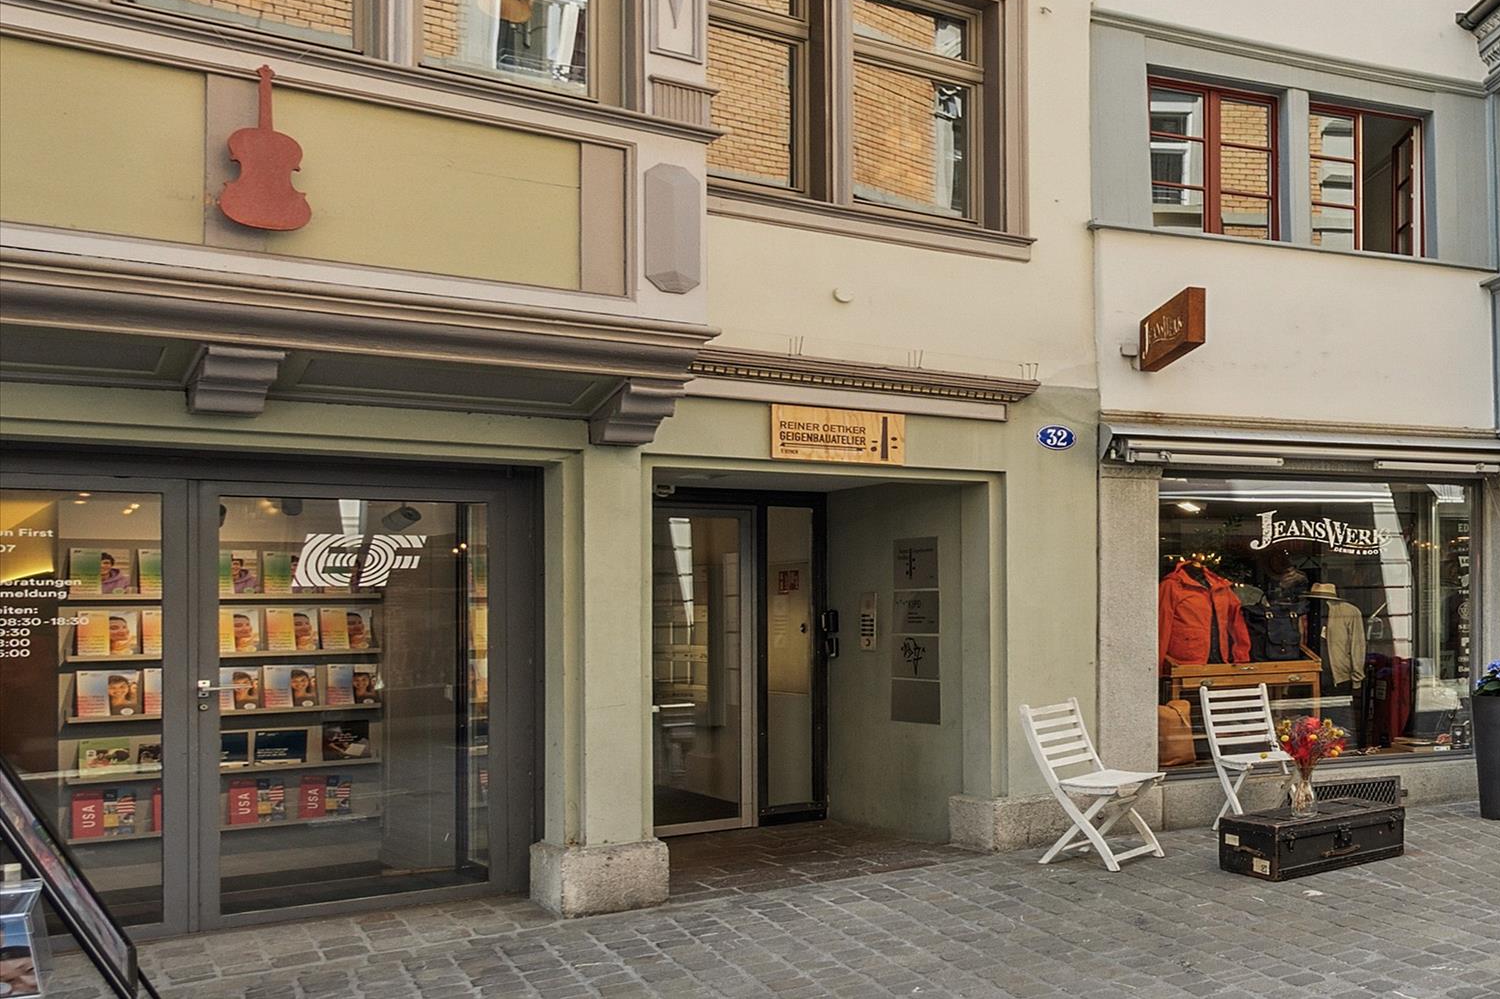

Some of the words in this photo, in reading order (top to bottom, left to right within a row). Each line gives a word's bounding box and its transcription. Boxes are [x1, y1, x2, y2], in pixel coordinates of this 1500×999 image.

[780, 420, 820, 432] REINER
[822, 423, 866, 435] OETIKER
[780, 430, 866, 446] GEIGENBAUATELIER
[1047, 429, 1067, 446] 32
[19, 528, 54, 538] First
[238, 792, 251, 815] USA
[307, 788, 319, 809] USA
[82, 804, 96, 828] USA
